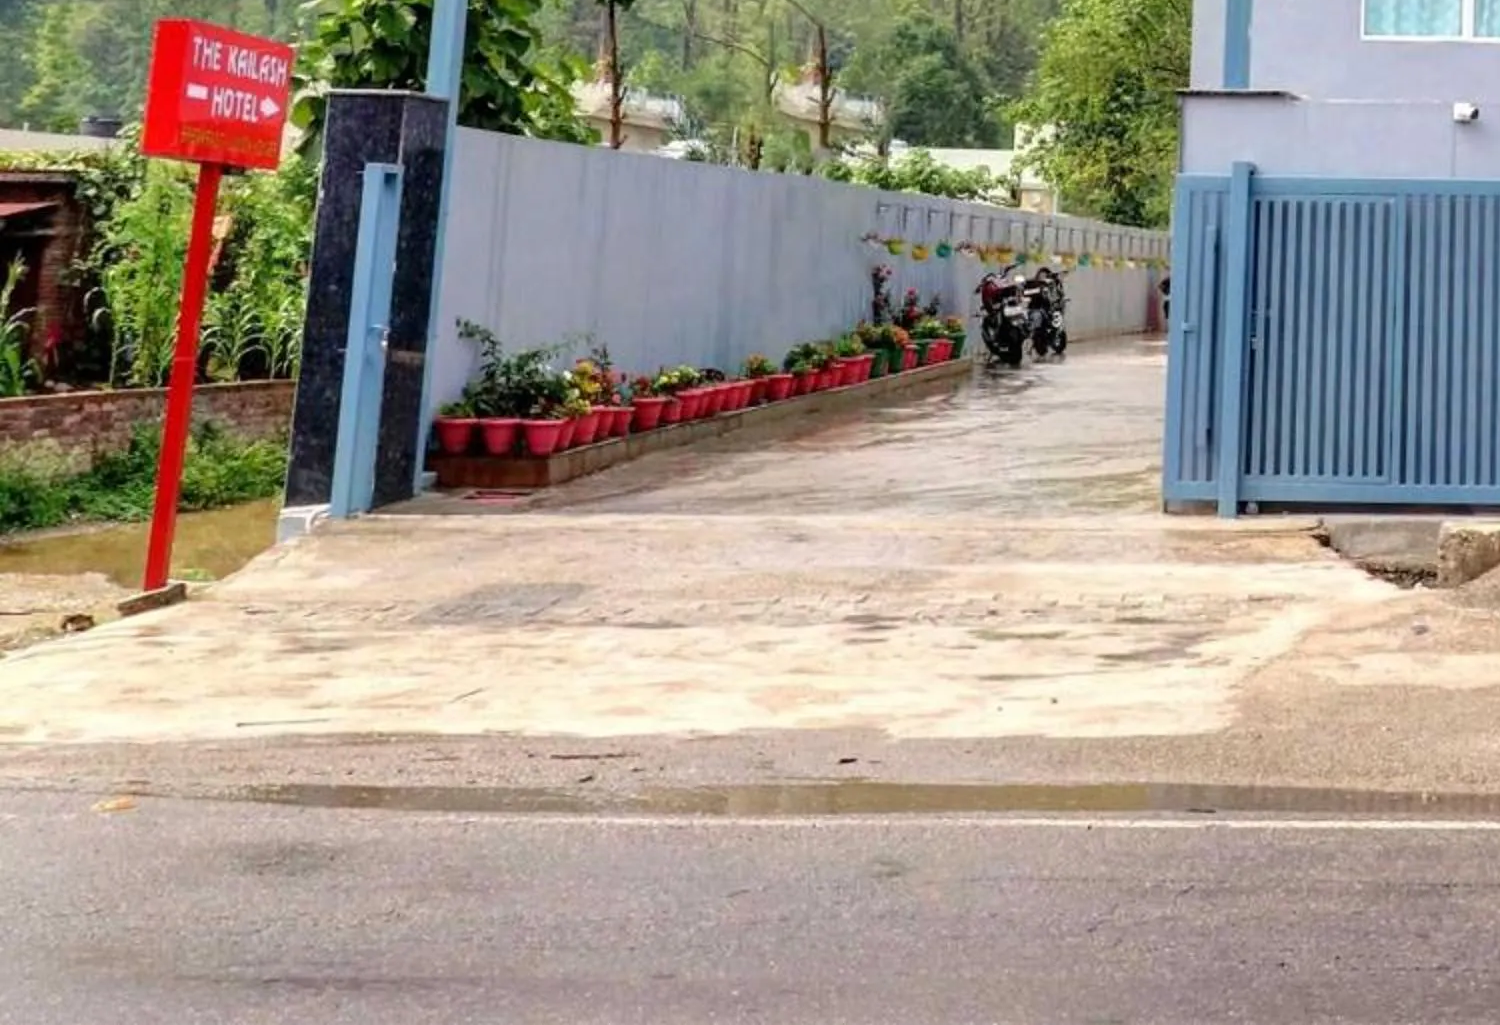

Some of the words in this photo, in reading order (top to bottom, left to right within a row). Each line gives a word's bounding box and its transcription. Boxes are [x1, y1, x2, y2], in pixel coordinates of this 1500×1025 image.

[192, 36, 223, 71] THE
[227, 46, 288, 87] KAILASH
[211, 86, 259, 123] HOTEL
